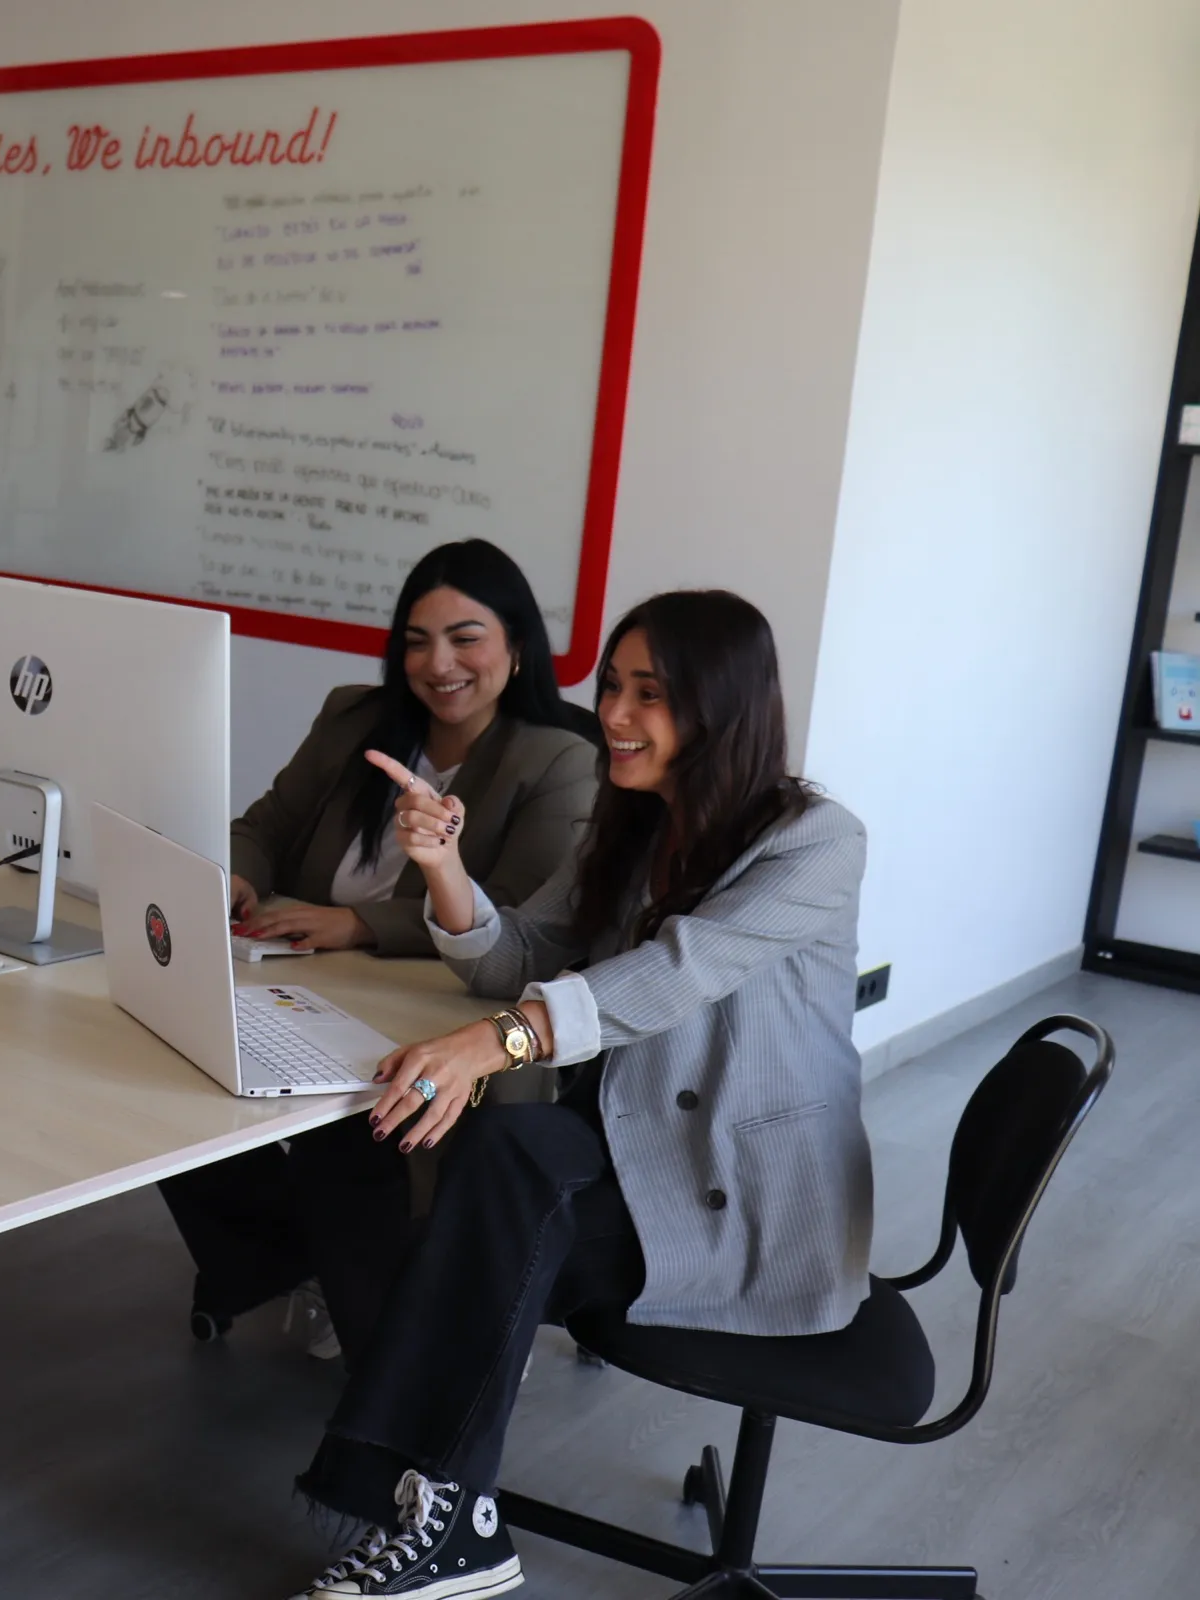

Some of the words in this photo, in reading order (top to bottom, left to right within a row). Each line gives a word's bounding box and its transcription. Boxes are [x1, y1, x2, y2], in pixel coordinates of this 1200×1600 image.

[66, 124, 122, 171] We
[134, 106, 338, 169] inbound!
[11, 655, 52, 715] hp
